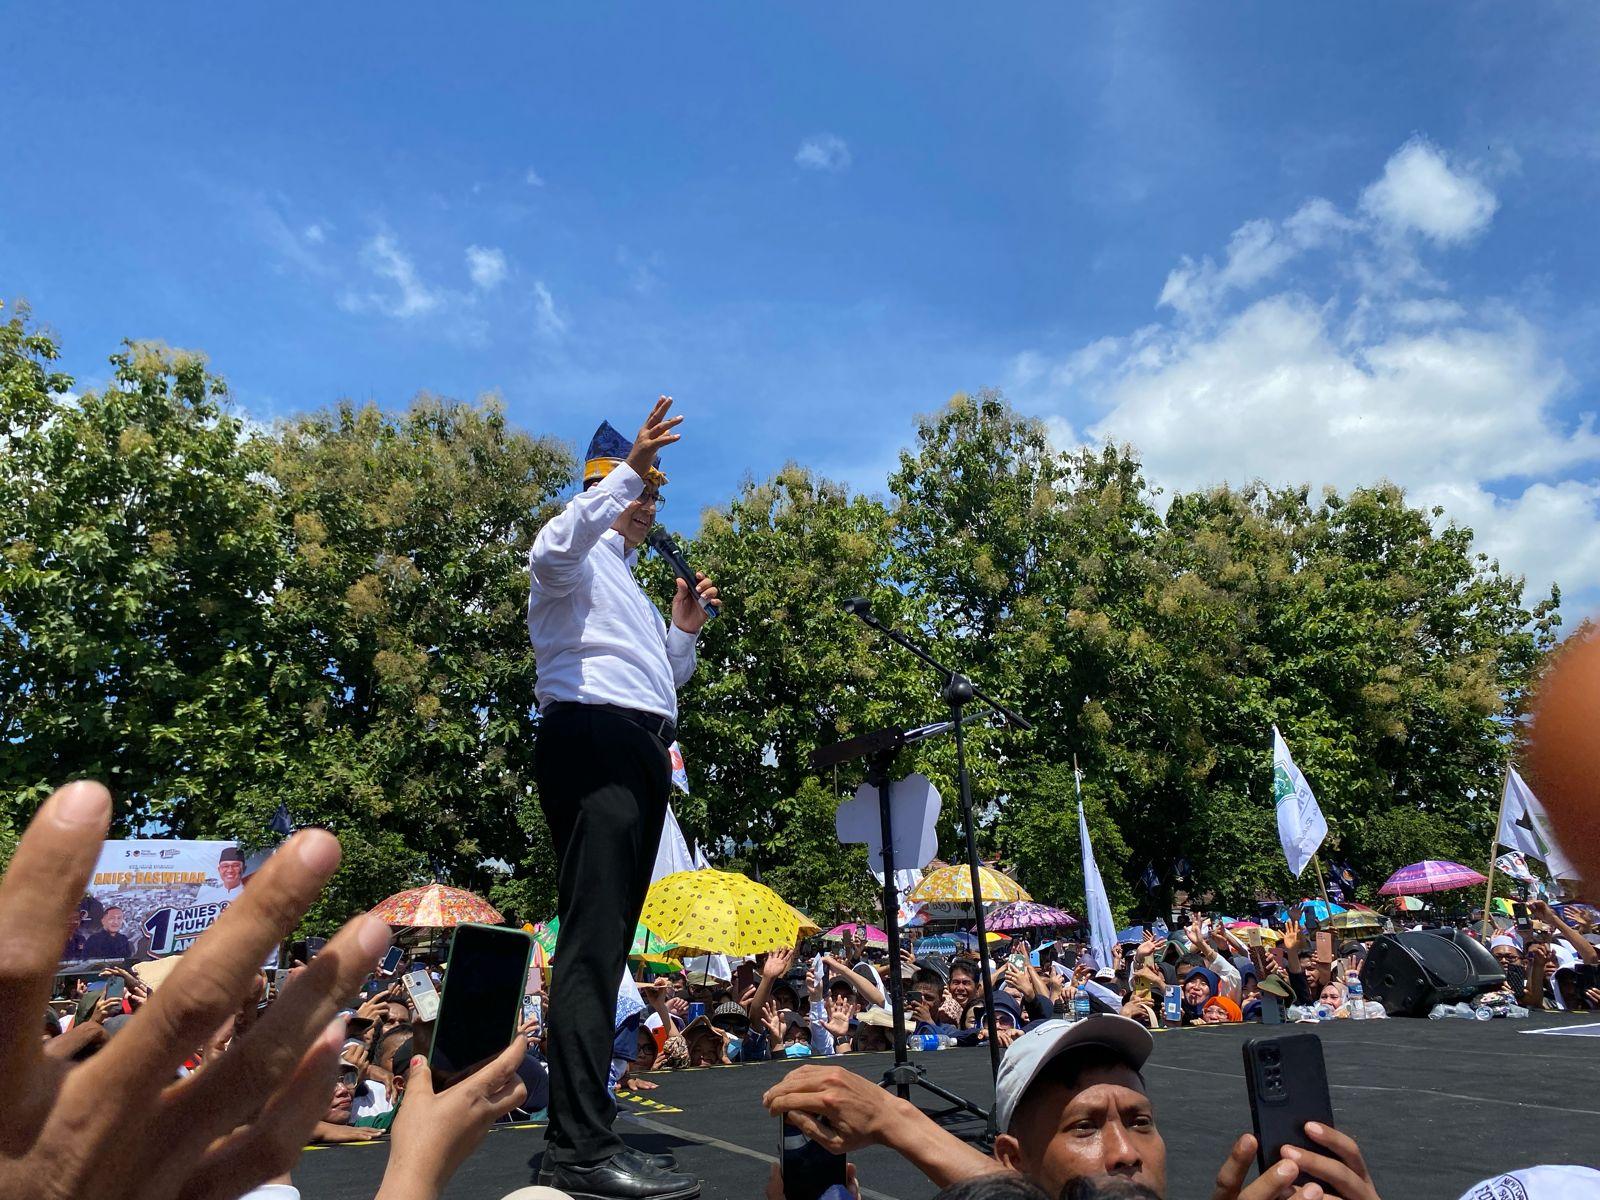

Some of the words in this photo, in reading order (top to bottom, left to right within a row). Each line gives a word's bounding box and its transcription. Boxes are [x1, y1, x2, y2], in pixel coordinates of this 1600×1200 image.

[94, 872, 132, 885] ANIES
[135, 871, 206, 885] BASWEDAN
[174, 904, 217, 922] ANIES
[145, 908, 172, 951] 1
[173, 916, 216, 933] MUHA
[1501, 1178, 1525, 1200] NEWYOR
